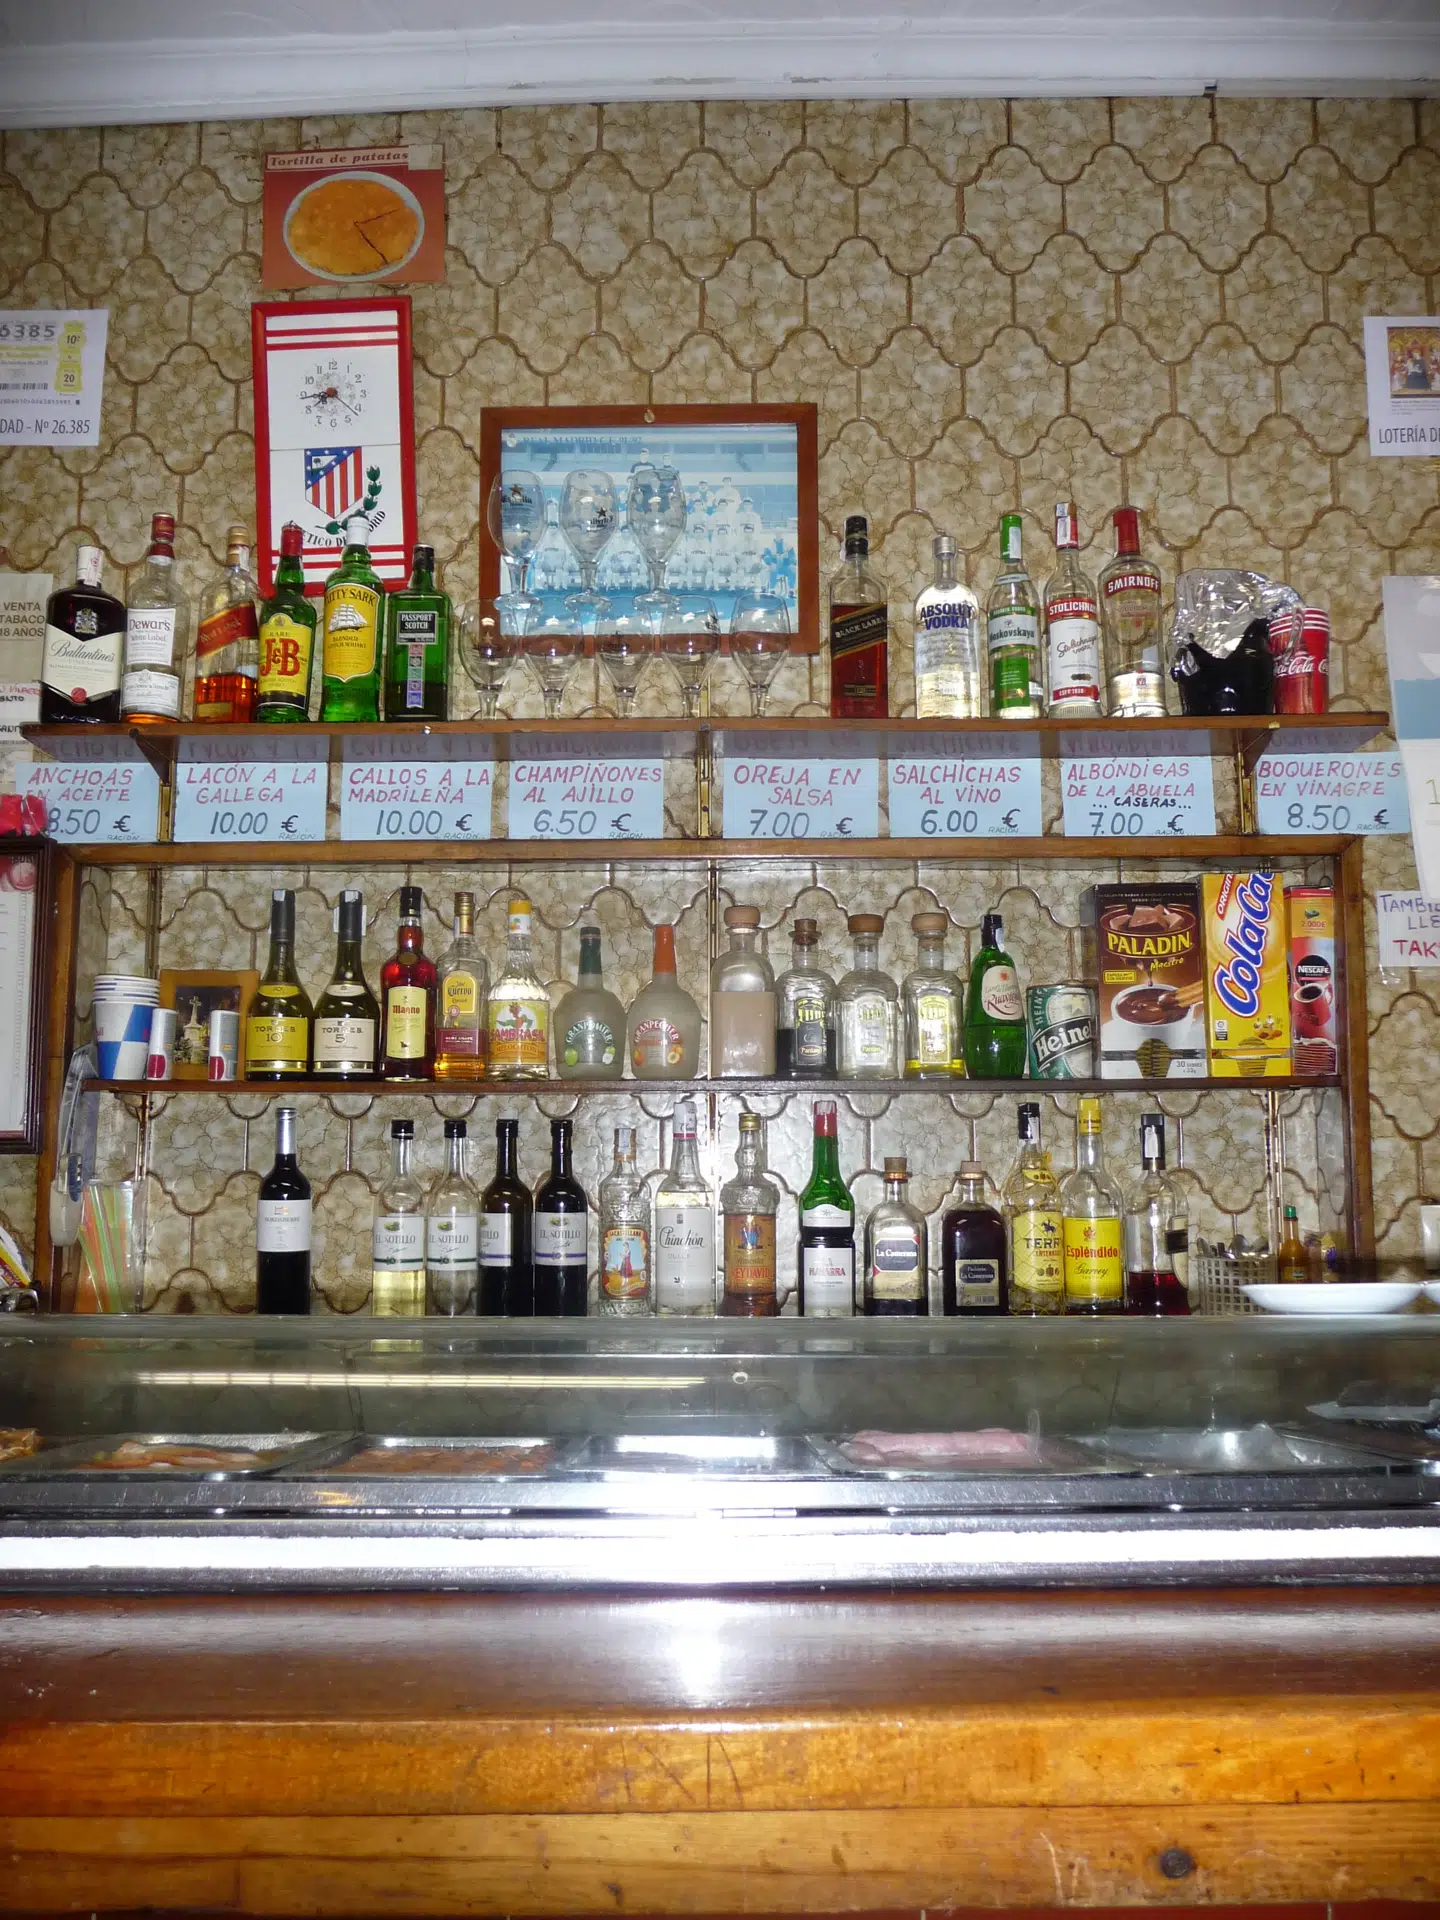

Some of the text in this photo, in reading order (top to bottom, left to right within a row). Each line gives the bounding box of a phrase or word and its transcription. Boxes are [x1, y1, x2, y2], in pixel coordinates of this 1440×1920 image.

[270, 152, 408, 167] Tortilla de patatas
[328, 361, 338, 370] 12
[63, 373, 75, 383] 20
[52, 419, 90, 434] 26.385
[1378, 424, 1427, 444] LOTERÍA
[1107, 574, 1160, 593] SMIRNOFF
[349, 588, 376, 607] SARK
[3, 602, 42, 612] VENTA
[920, 602, 973, 620] ABSOLUT
[0, 614, 45, 625] TABACO
[129, 618, 171, 632] Dewar's
[401, 613, 433, 622] PASSPORT
[404, 621, 428, 630] SCOTCH
[925, 615, 969, 631] VODKA
[12, 625, 45, 637] AÑOS
[835, 624, 861, 639] BLACK
[260, 638, 301, 677] J&B
[27, 766, 133, 786] ANCHOAS
[186, 763, 318, 785] LACÓN A LA
[349, 767, 491, 786] CALLOS A LA
[733, 764, 862, 786] OREJA EN
[1258, 761, 1401, 779] BOQUERONES
[195, 786, 284, 805] GALLEGA
[522, 786, 546, 803] AL
[768, 787, 833, 807] SALSA
[920, 787, 944, 804] AL
[1066, 783, 1196, 798] DE LA ABUELA
[1261, 781, 1283, 797] EN
[48, 807, 131, 835] 8.50 €
[209, 810, 299, 836] 10.00 €
[376, 809, 473, 835] 10.00 €
[533, 809, 632, 835] 6.50 €
[749, 808, 853, 839] 7.00 €
[920, 808, 1021, 835] 6.00 €
[1089, 812, 1184, 836] 7.00 €
[1287, 803, 1390, 831] 8.50 €
[1217, 873, 1234, 916] ORIGIN
[1107, 930, 1190, 956] PALADIN
[1392, 939, 1440, 960] TAK
[448, 986, 472, 997] Cuervo
[392, 1004, 421, 1016] Magno
[266, 1032, 283, 1043] 10
[334, 1033, 346, 1044] 5
[1065, 1244, 1119, 1259] Espléndido
[1074, 1261, 1109, 1277] Garvey
